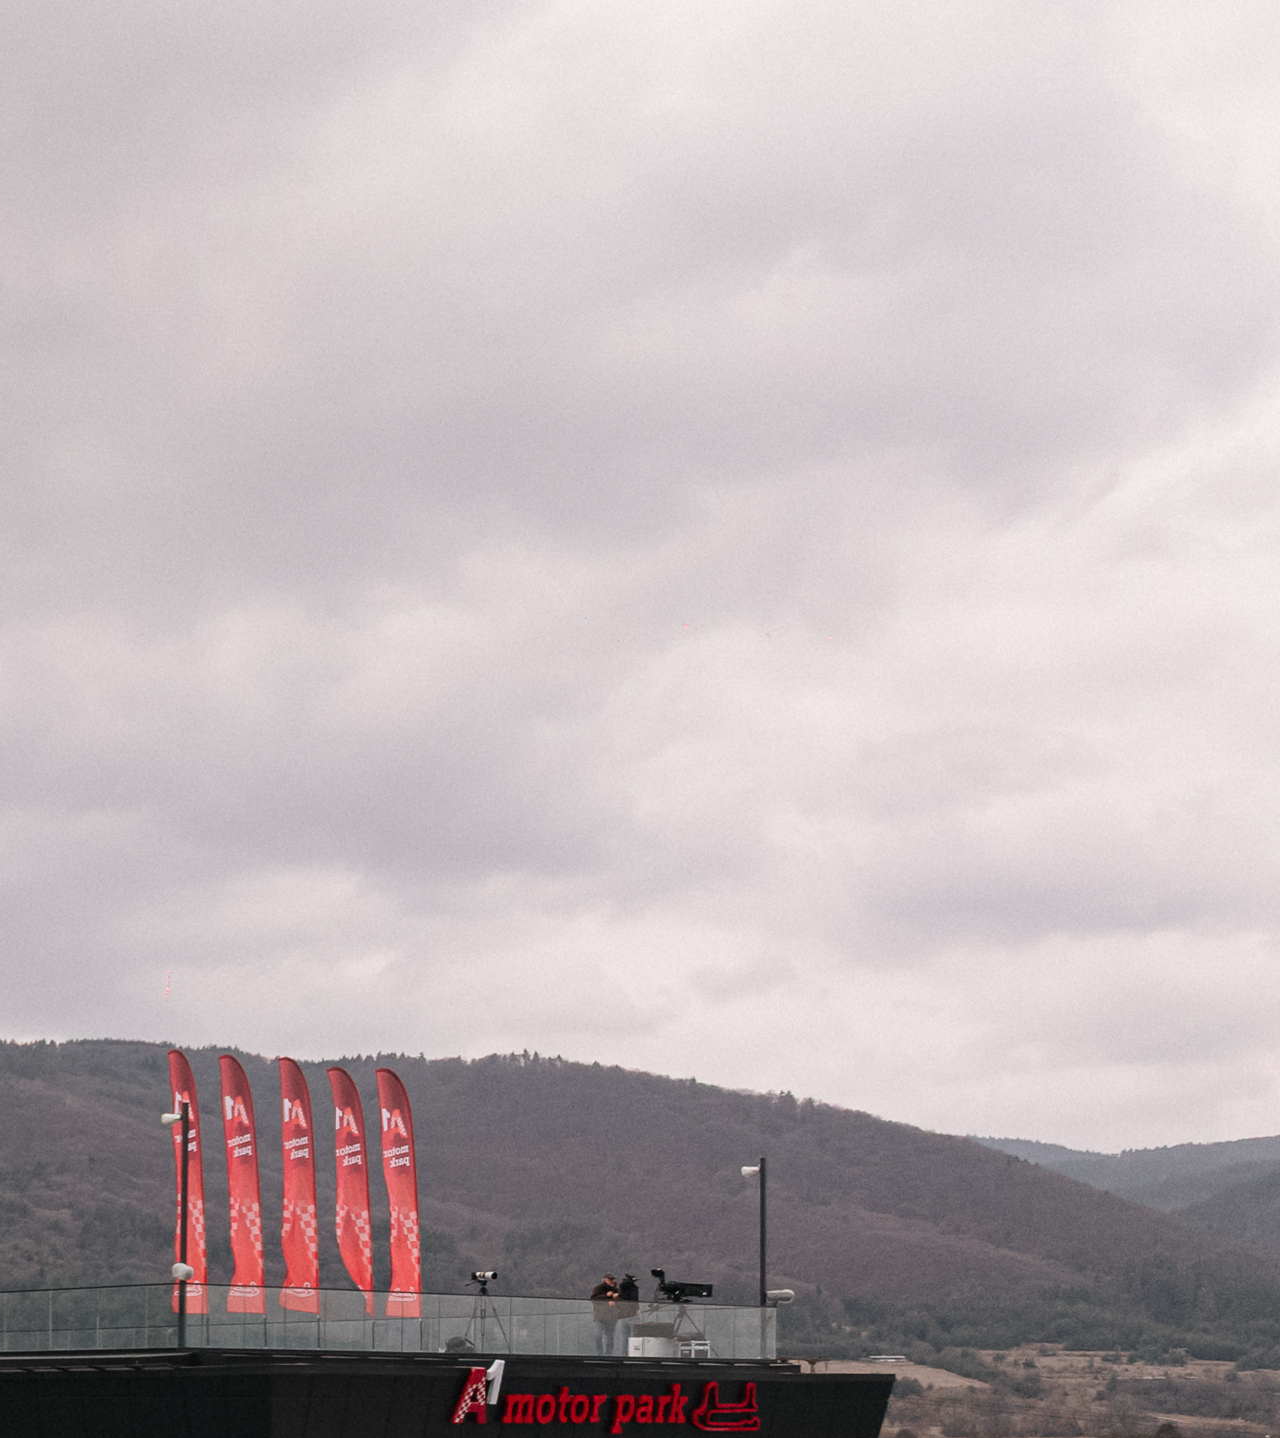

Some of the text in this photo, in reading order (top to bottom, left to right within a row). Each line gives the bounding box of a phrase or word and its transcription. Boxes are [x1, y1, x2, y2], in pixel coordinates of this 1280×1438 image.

[450, 1359, 689, 1435] A1 motor park
